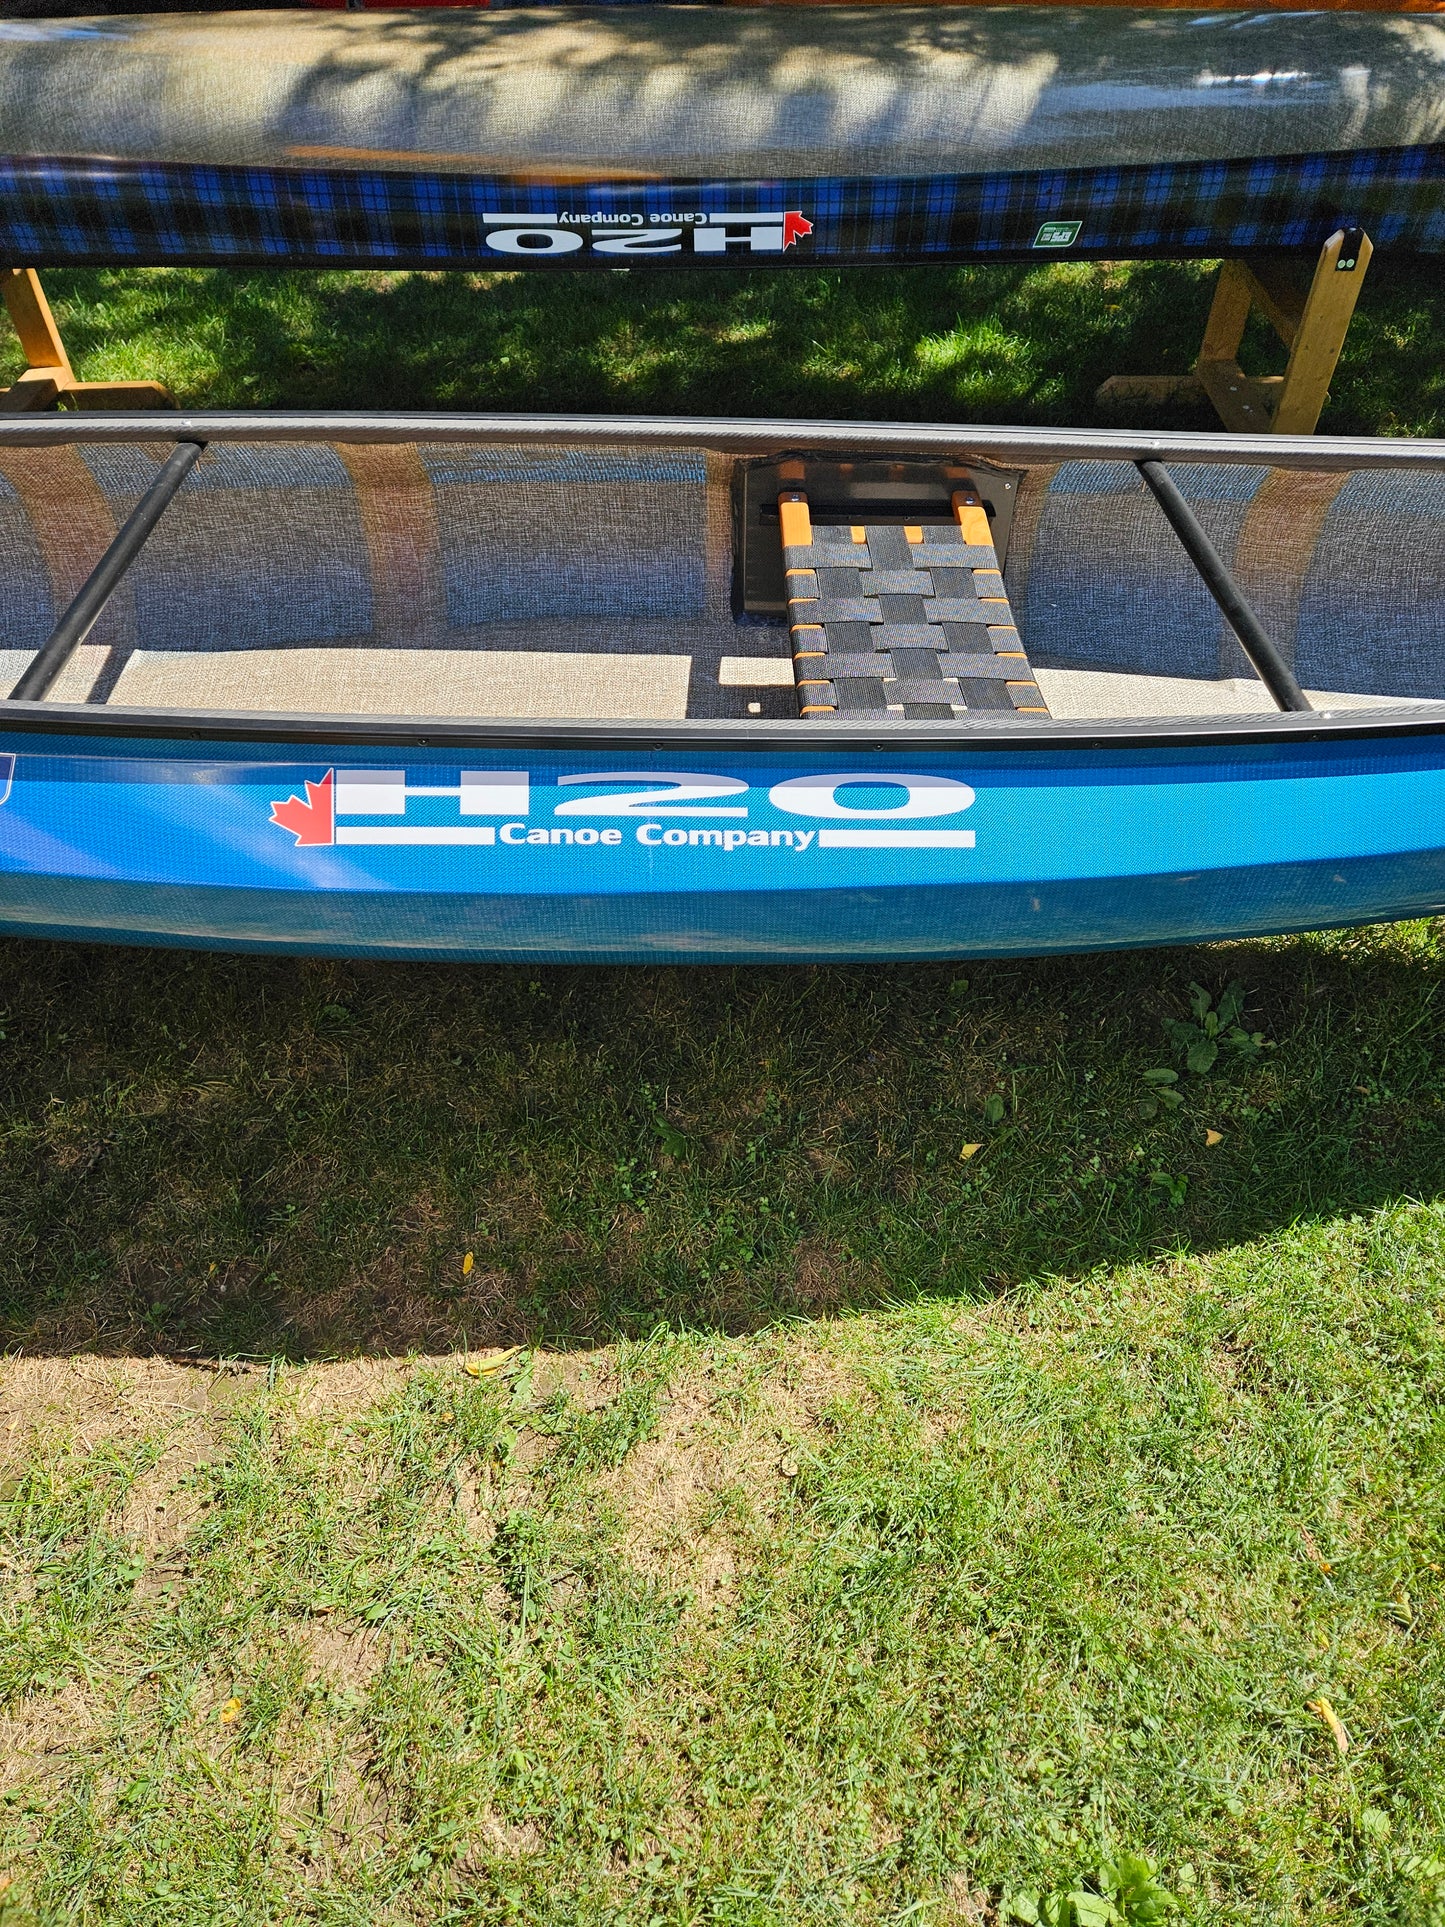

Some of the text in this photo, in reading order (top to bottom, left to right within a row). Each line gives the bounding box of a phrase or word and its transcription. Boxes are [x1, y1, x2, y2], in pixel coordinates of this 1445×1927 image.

[558, 212, 708, 226] Canoe Company
[499, 822, 817, 852] Canoe Company
